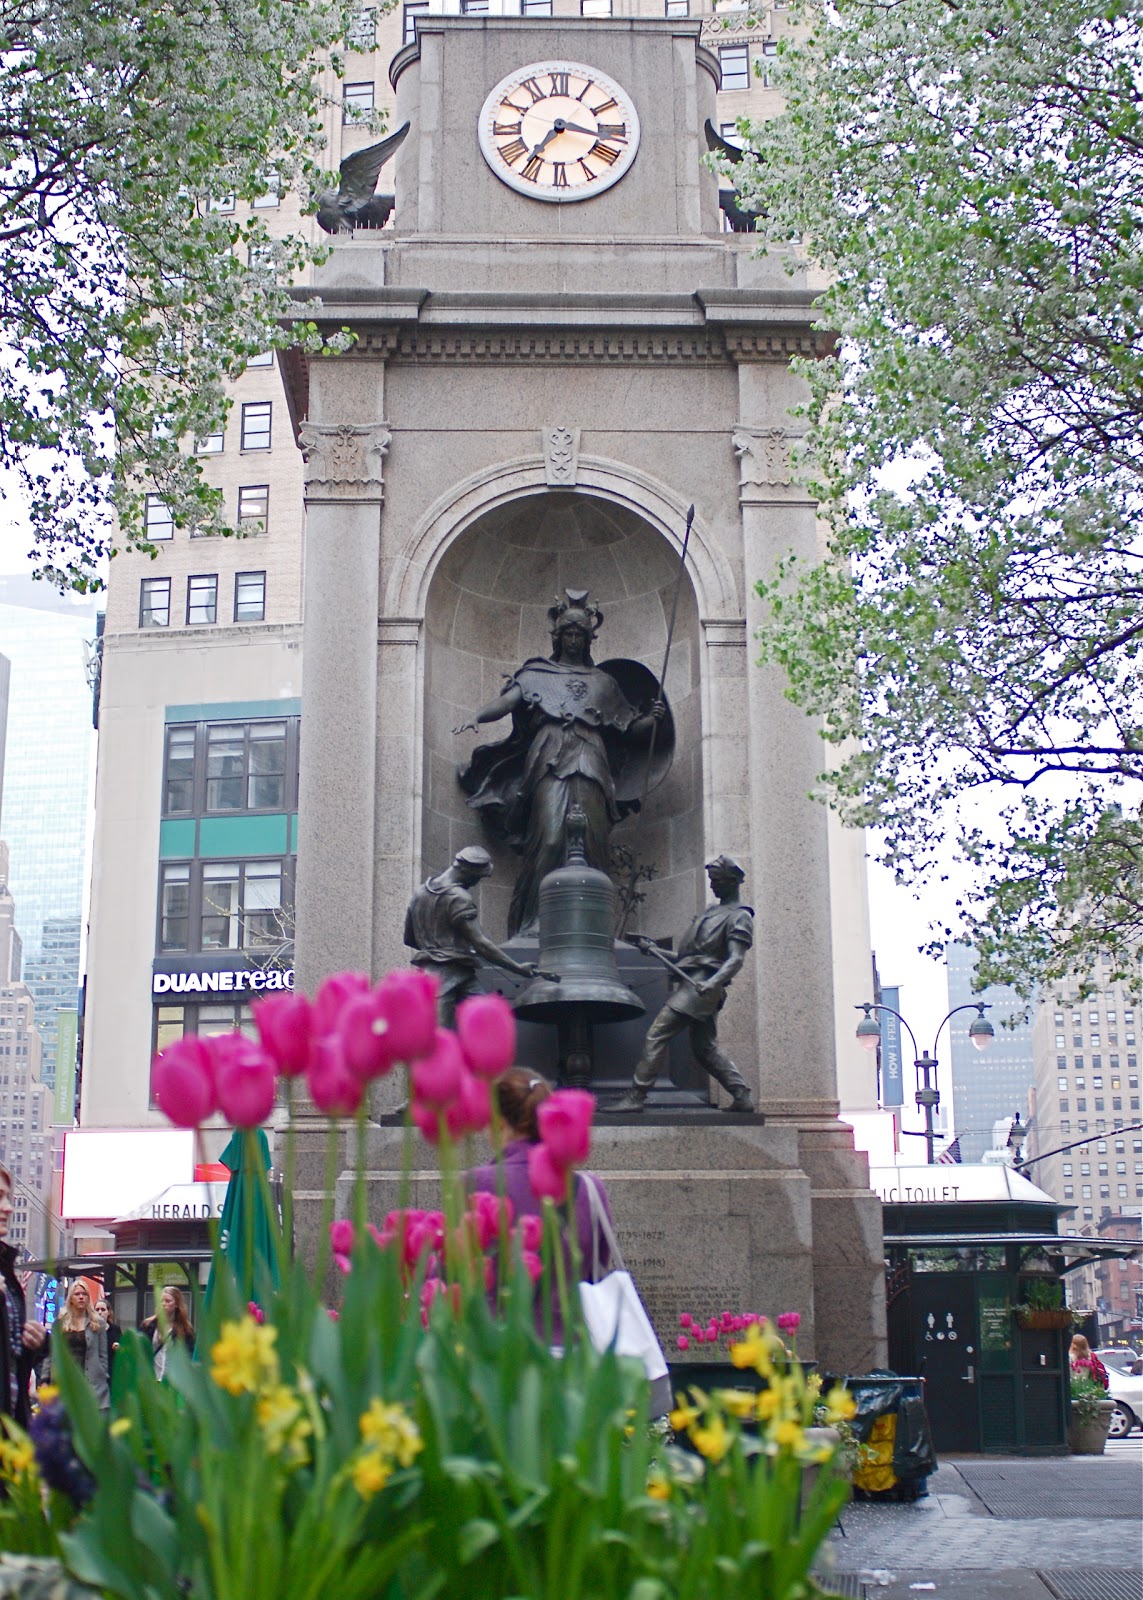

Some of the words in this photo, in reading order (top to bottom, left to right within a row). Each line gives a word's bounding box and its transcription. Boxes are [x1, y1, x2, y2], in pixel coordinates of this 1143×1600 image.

[520, 77, 547, 104] XI
[548, 72, 571, 97] XII
[576, 79, 594, 102] I
[500, 96, 529, 116] X
[590, 97, 618, 116] II
[493, 120, 522, 136] IX
[497, 136, 530, 167] VIII
[518, 154, 545, 183] VII
[552, 161, 571, 187] VI
[576, 157, 598, 182] V
[888, 1052, 898, 1079] HOW
[905, 1187, 959, 1202] TOILET
[152, 1204, 211, 1219] HERALD
